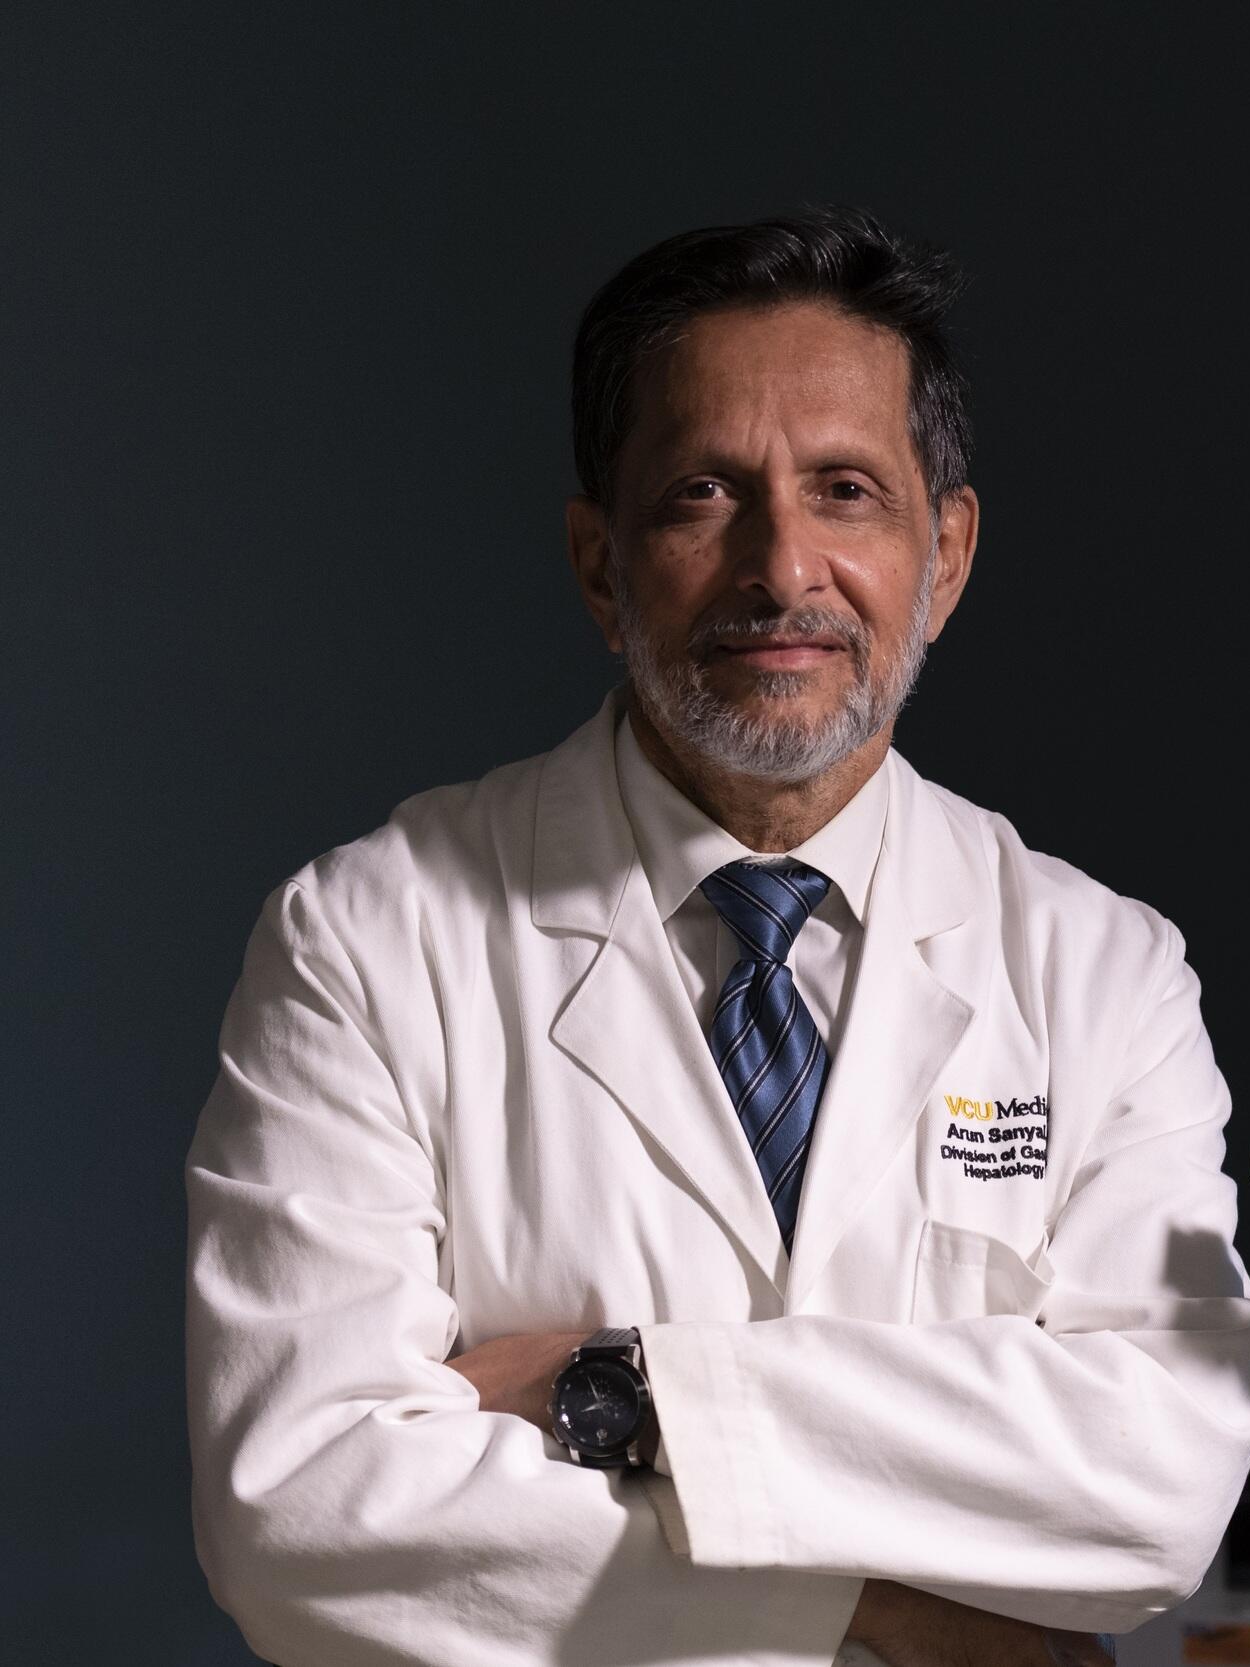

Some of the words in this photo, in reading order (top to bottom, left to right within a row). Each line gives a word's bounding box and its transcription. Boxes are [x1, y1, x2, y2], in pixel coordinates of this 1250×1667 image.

[944, 1095, 992, 1121] VCU
[994, 1095, 1047, 1120] Medi
[947, 1123, 985, 1143] Arun
[940, 1144, 998, 1163] Division
[1000, 1146, 1016, 1161] of
[963, 1162, 1045, 1181] Hepatology
